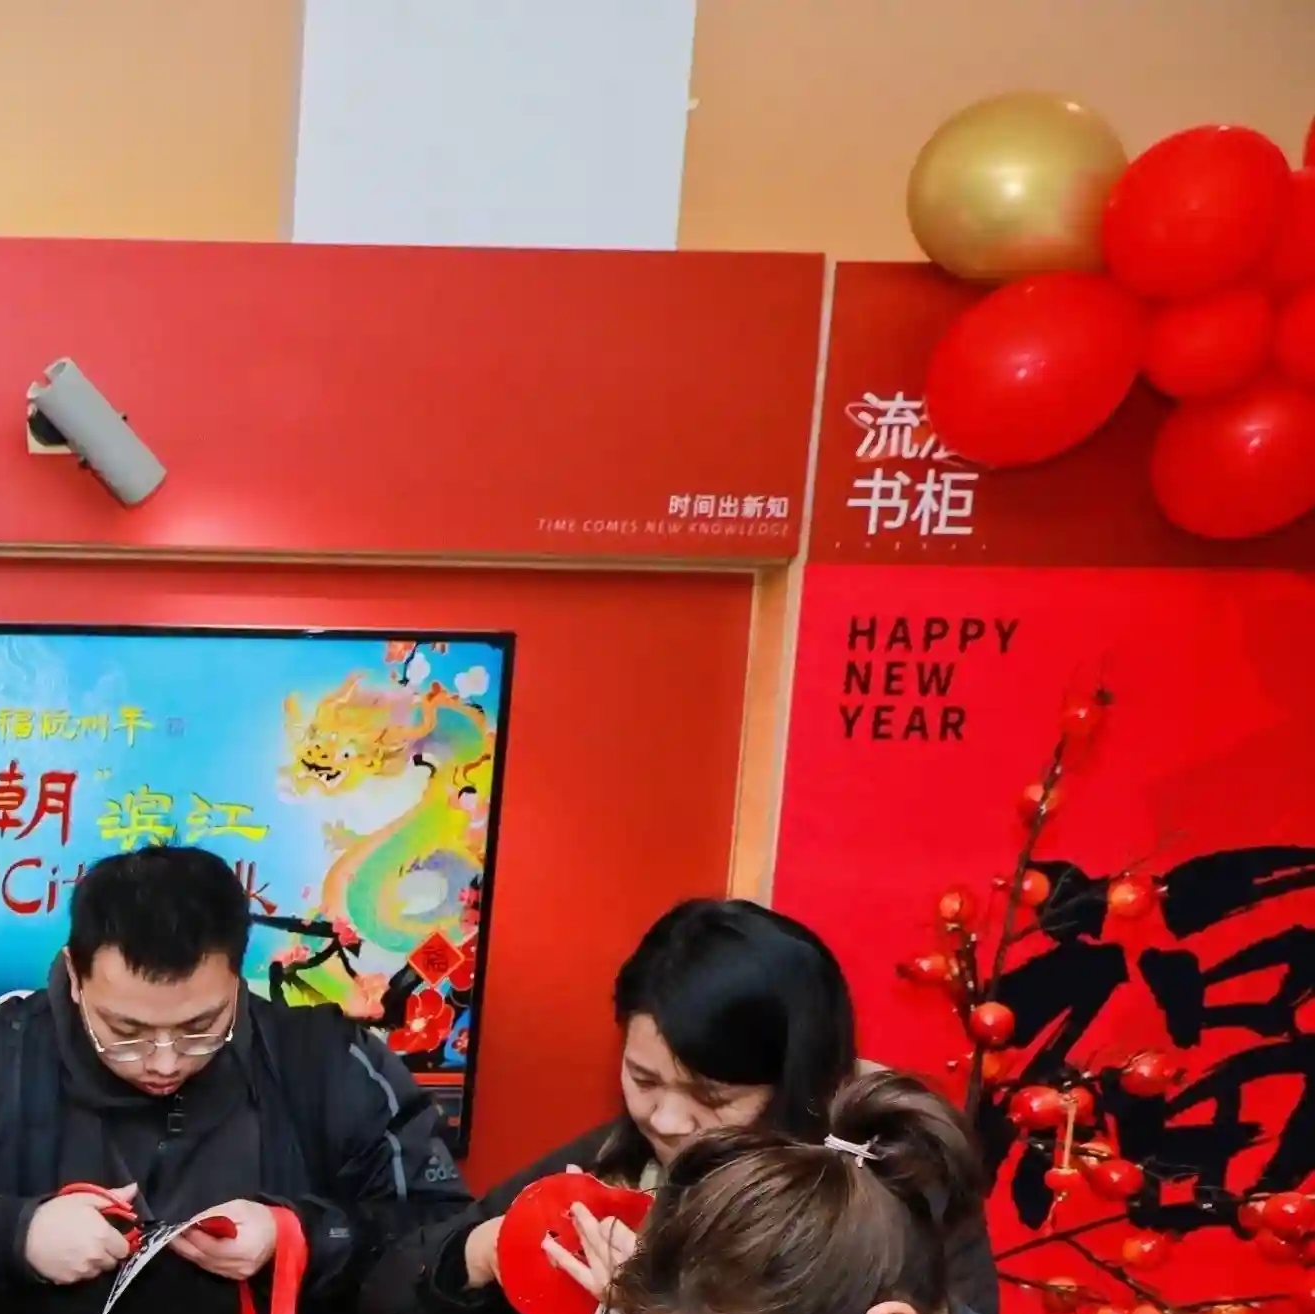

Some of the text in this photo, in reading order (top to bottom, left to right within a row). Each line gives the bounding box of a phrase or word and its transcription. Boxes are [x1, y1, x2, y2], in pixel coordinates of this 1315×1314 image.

[855, 391, 960, 460] 流
[668, 495, 789, 518] 时间出新知
[848, 468, 979, 535] 书柜
[536, 517, 790, 538] TIME COMES NEW KNOWLEDGE
[847, 616, 1020, 653] HAPPY
[842, 662, 956, 697] NEW
[839, 706, 968, 741] YEAR
